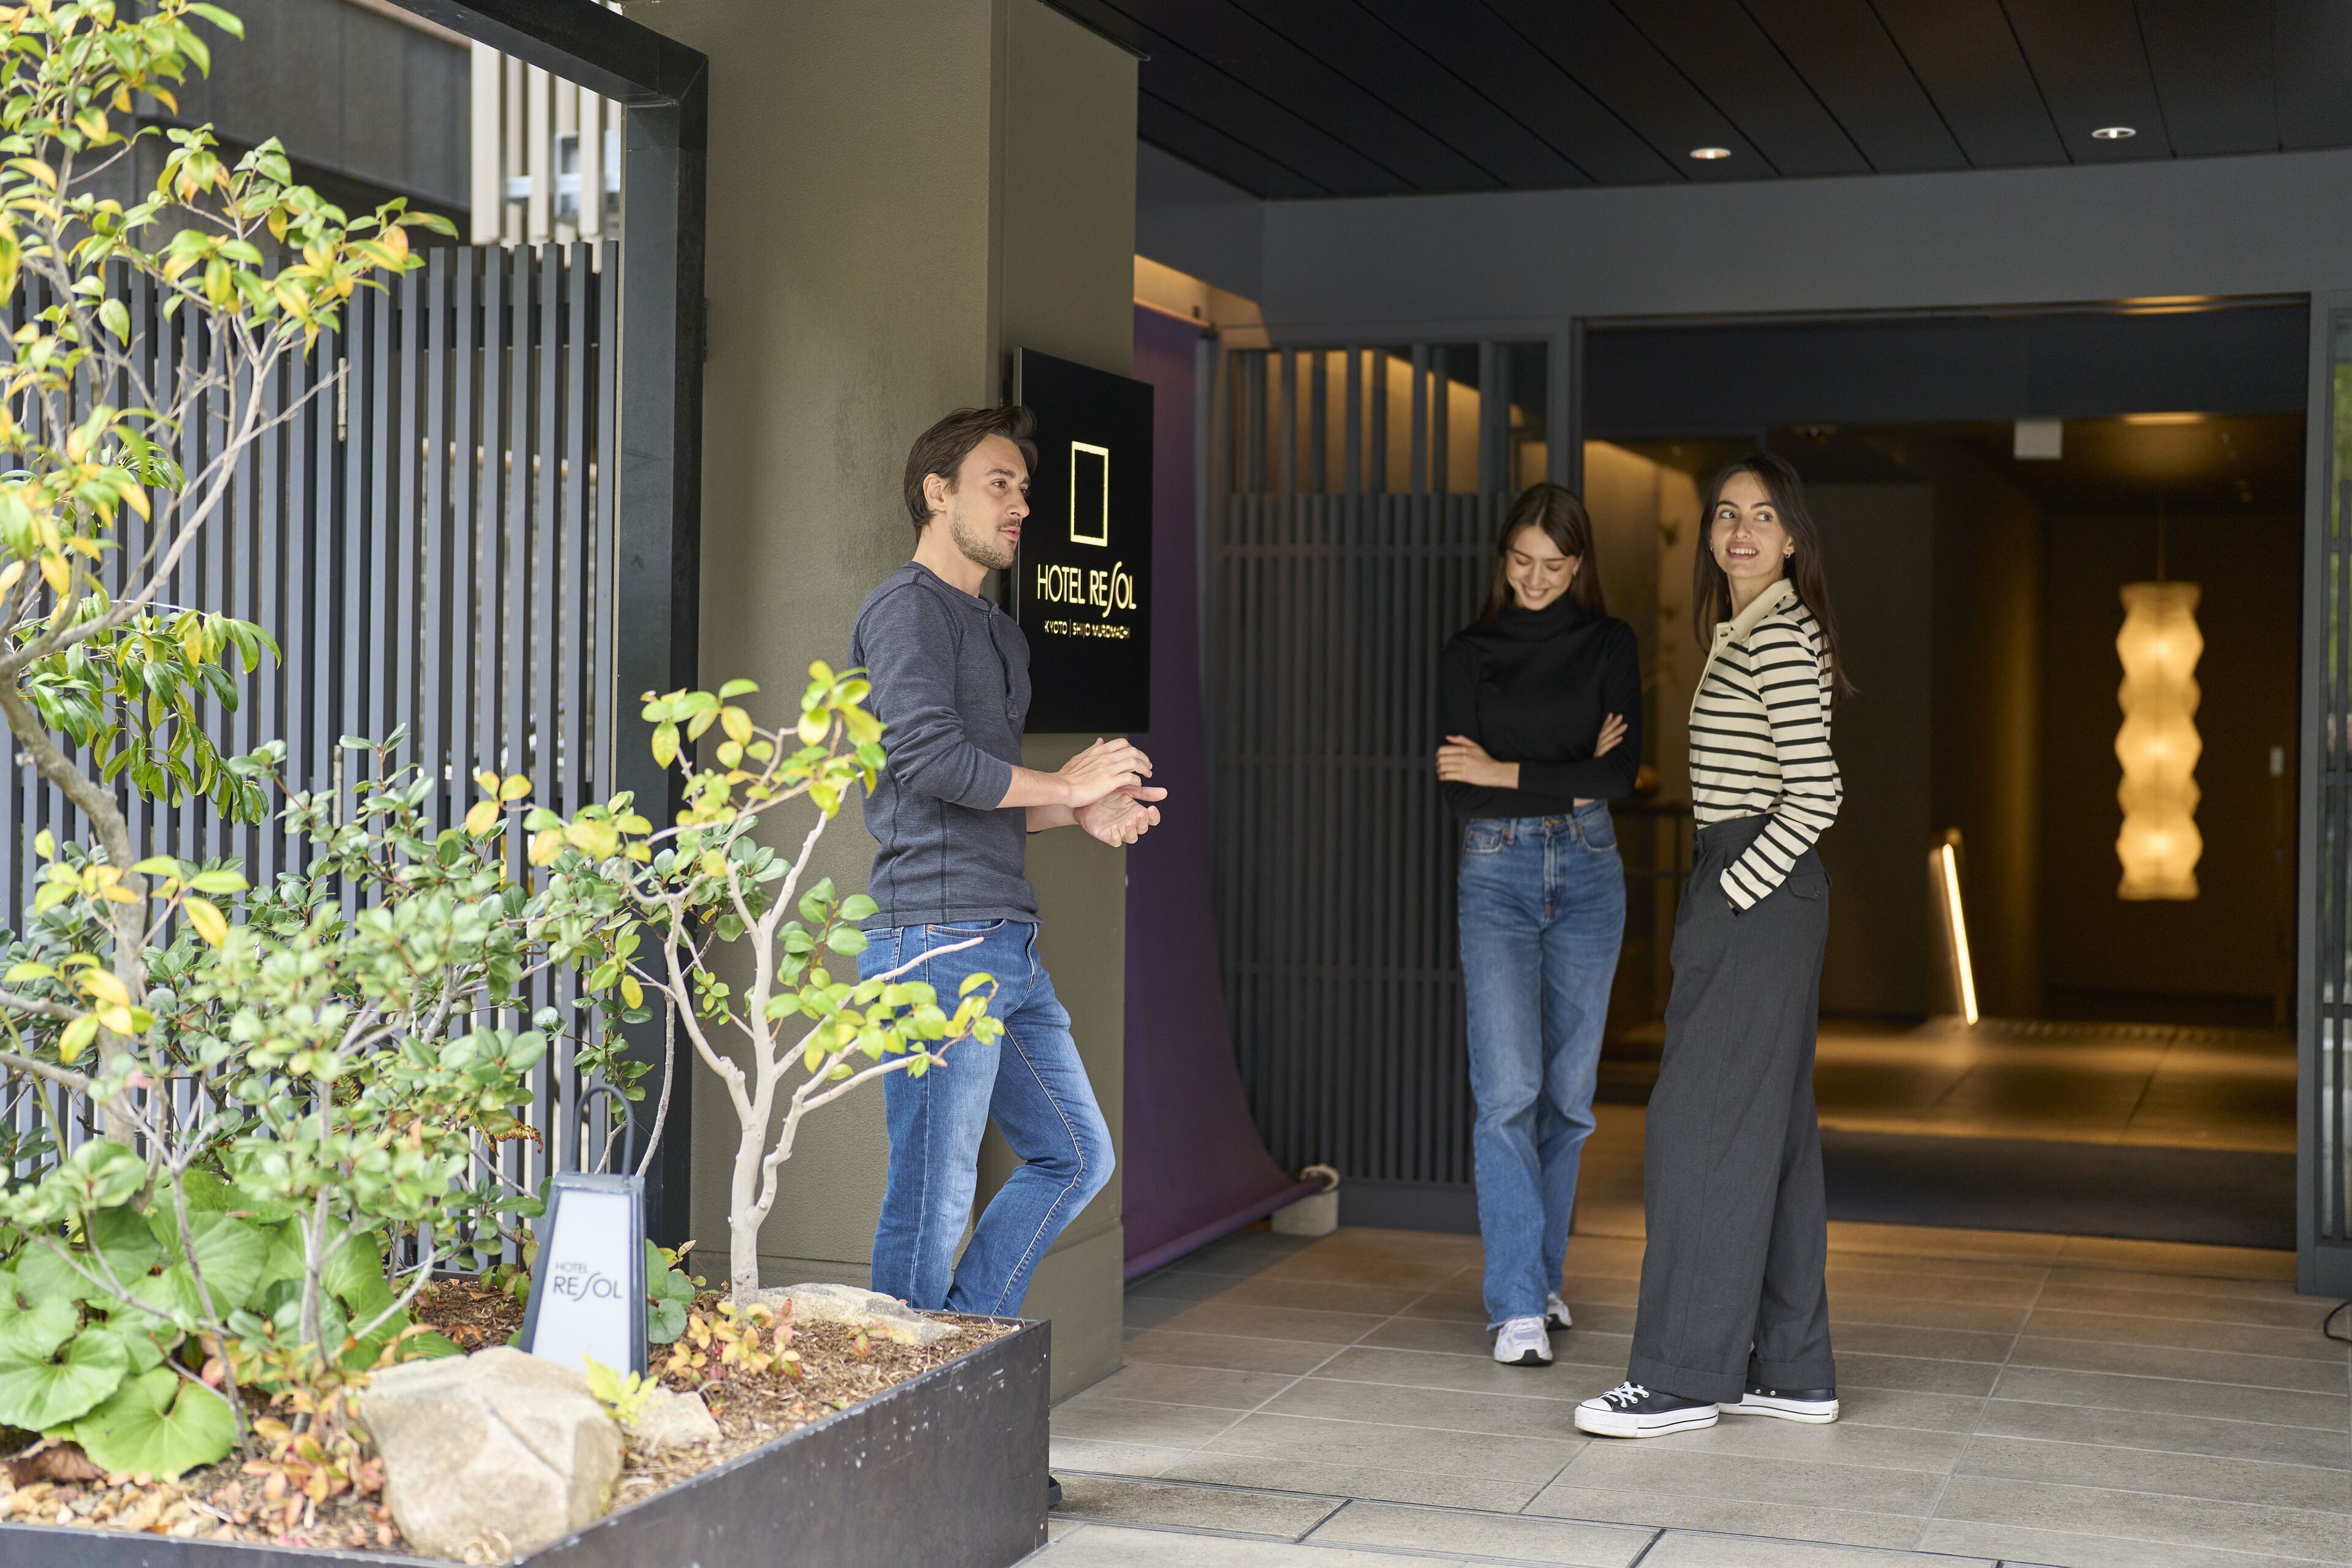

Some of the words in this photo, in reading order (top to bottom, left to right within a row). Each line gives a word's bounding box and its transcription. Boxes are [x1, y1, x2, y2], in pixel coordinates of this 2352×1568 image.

[1037, 564, 1085, 604] HOTEL
[1090, 561, 1137, 618] RESOL
[1044, 620, 1068, 635] KYOTO
[555, 1263, 588, 1274] HOTEL
[554, 1272, 622, 1302] RESOL
